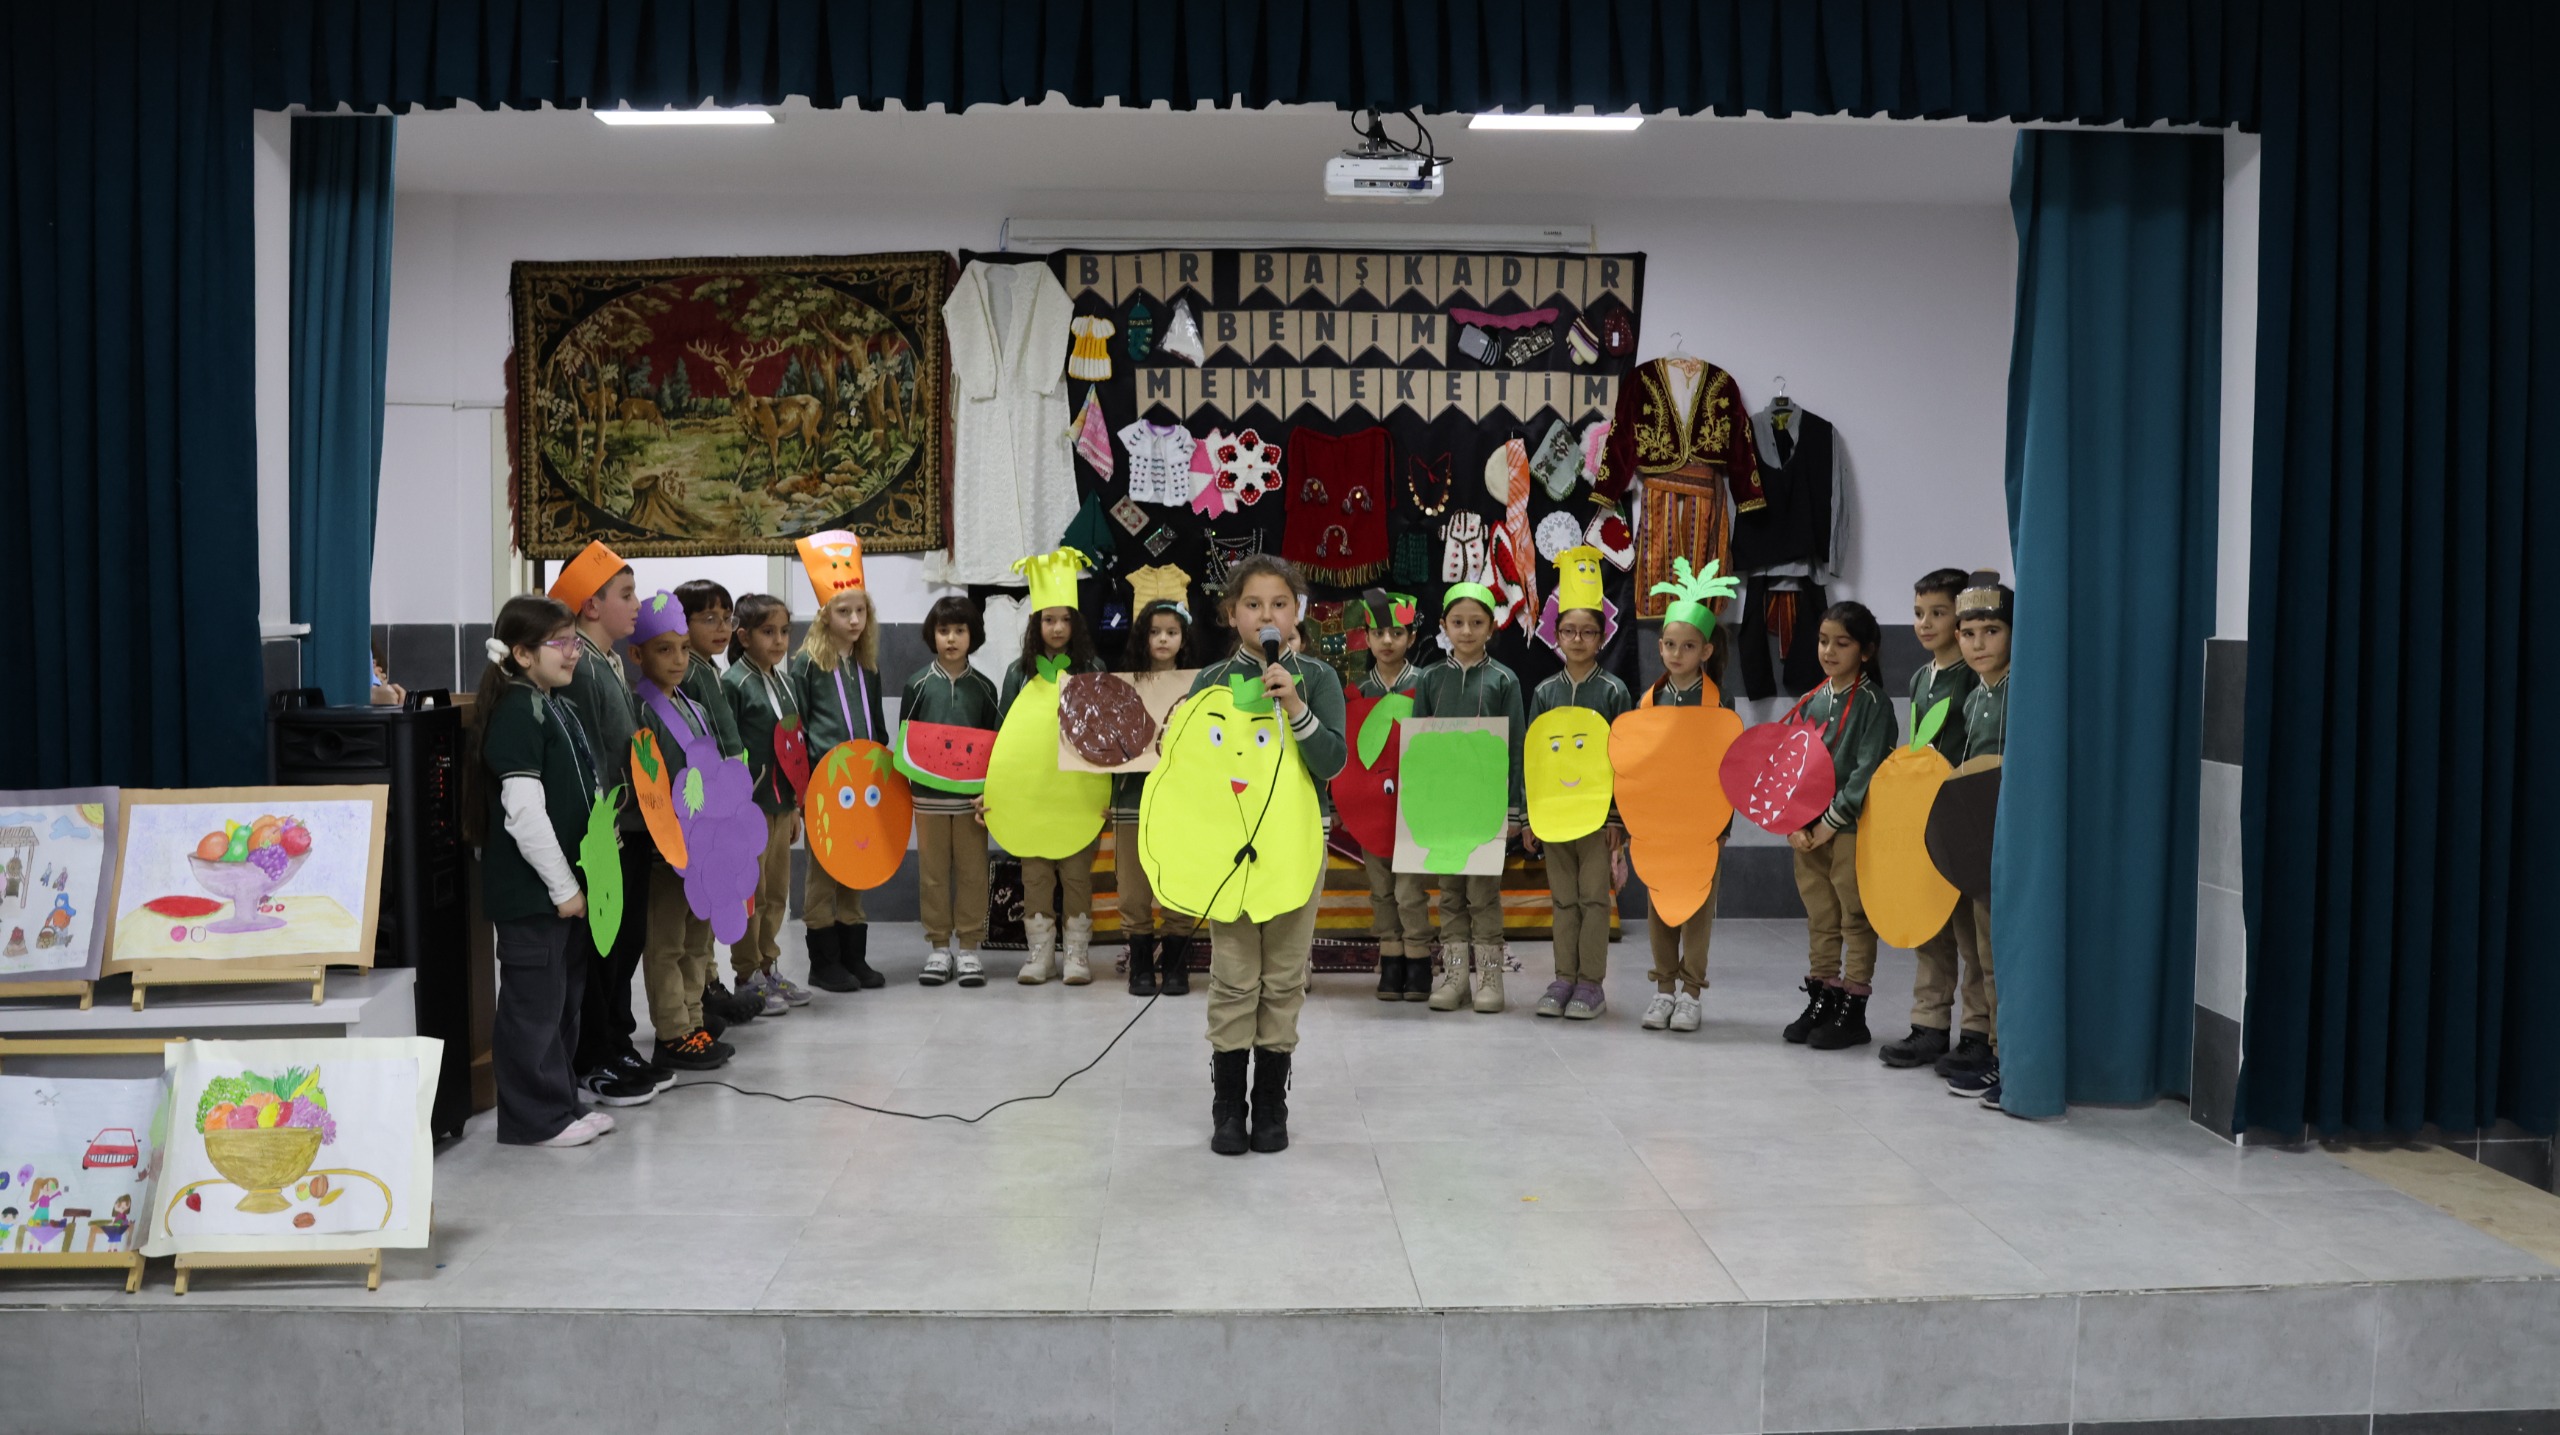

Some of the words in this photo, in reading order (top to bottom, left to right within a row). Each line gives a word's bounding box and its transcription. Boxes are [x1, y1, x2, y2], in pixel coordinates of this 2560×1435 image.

[1081, 254, 1199, 285] BİR
[1254, 254, 1619, 287] BAŞKADIR
[1218, 312, 1436, 343] BENİM
[1147, 370, 1607, 405] MEMLEKETİM
